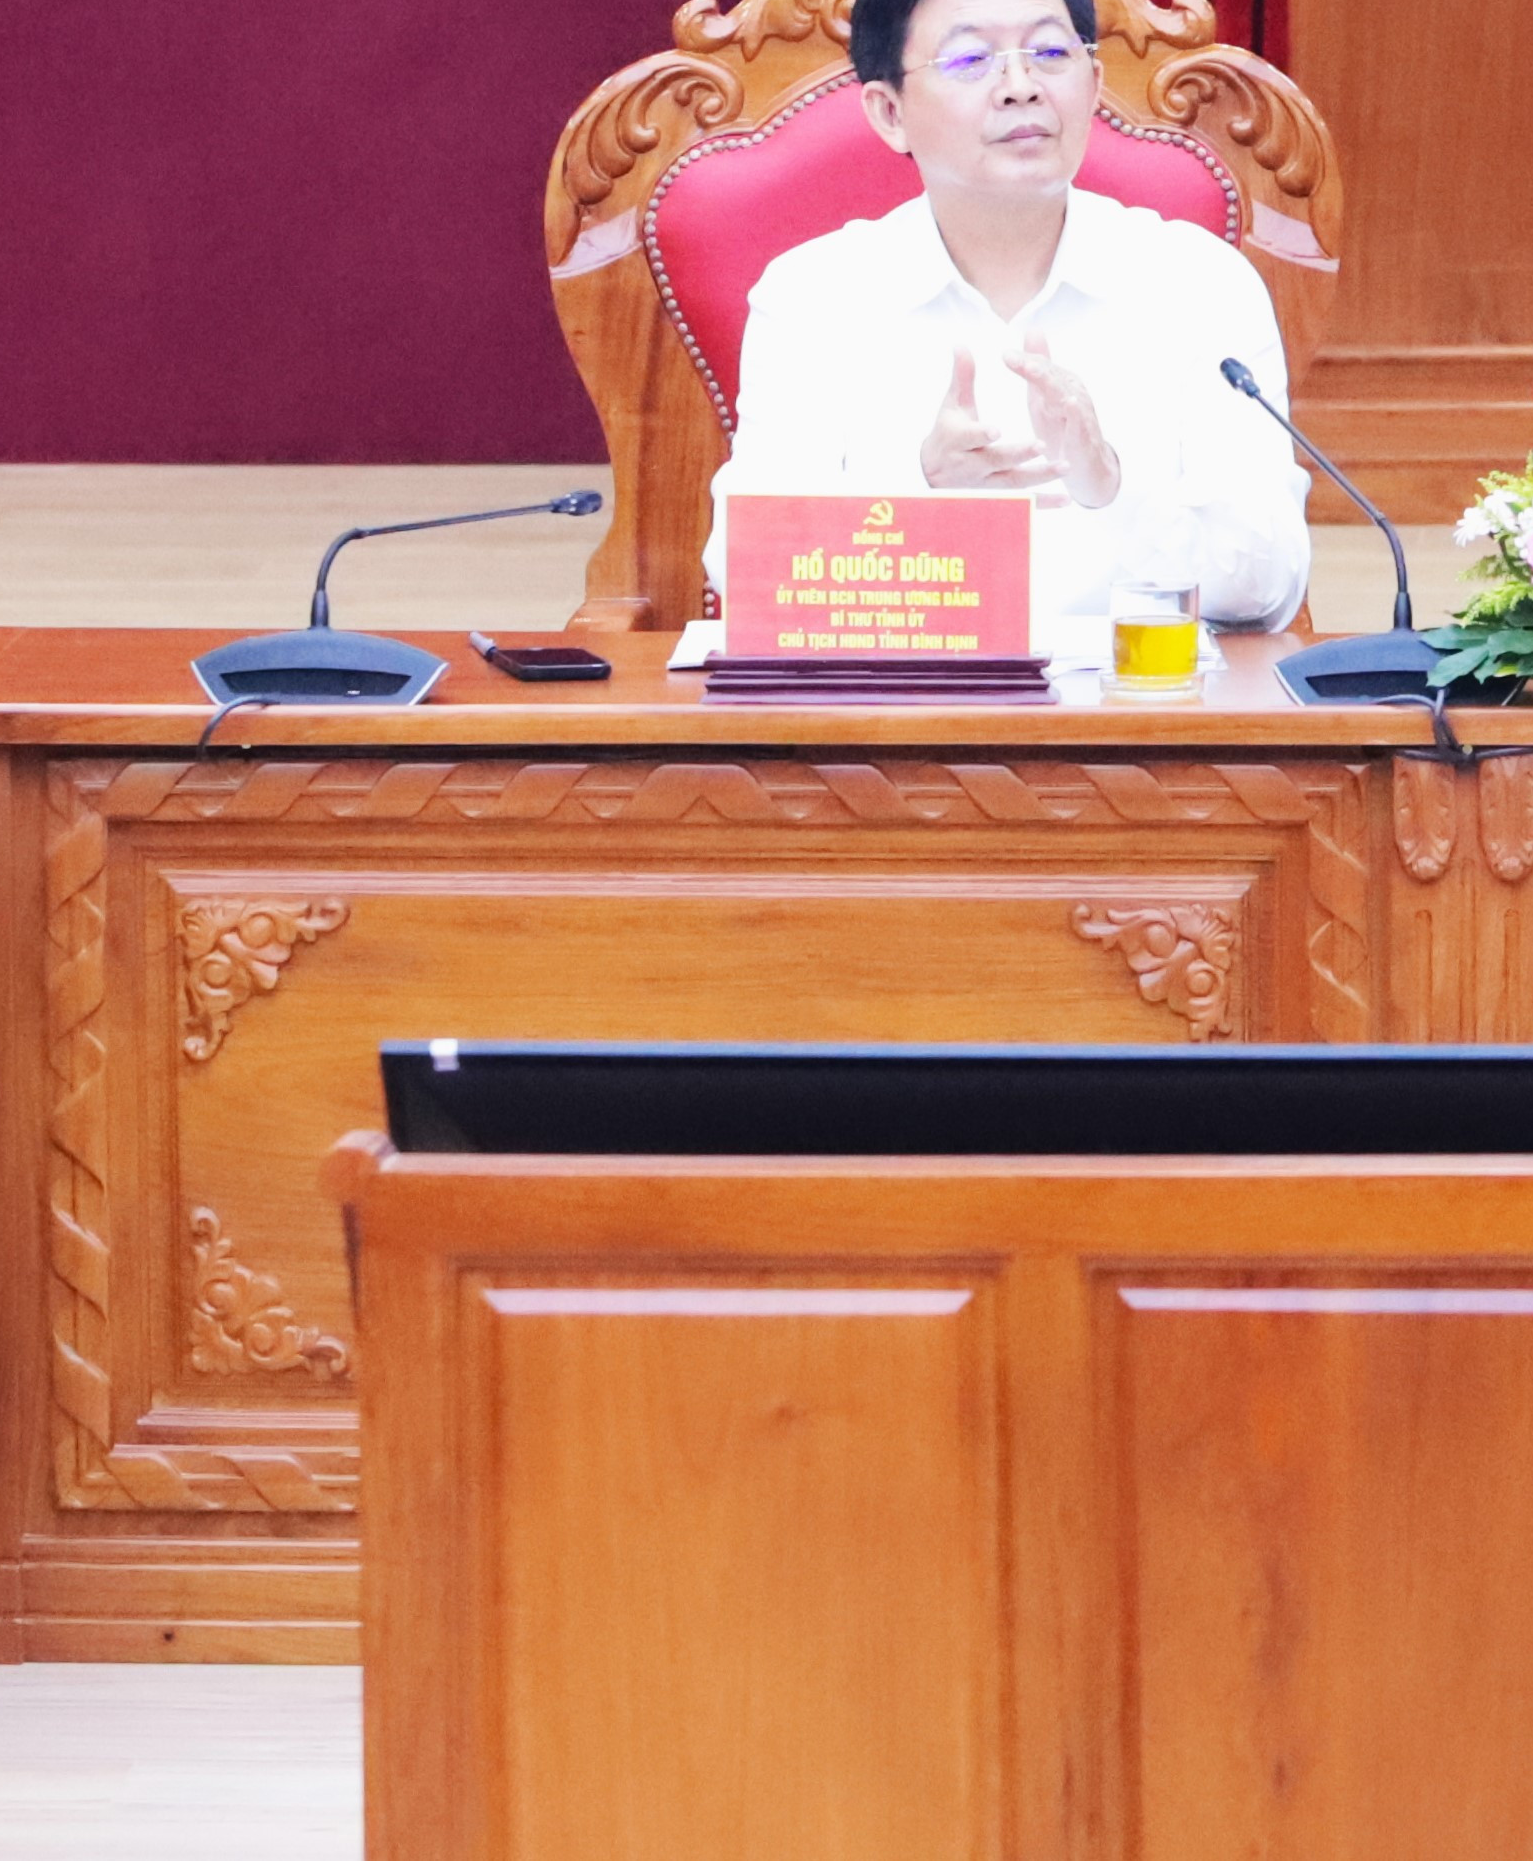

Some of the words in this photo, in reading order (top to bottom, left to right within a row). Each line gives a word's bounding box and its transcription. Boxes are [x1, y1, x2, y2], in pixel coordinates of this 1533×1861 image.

[792, 547, 824, 581] HỒ
[830, 548, 894, 584] QUỐC
[899, 552, 965, 582] DŨNG
[776, 584, 793, 605] ỦY
[796, 588, 827, 605] VIÊN
[858, 591, 902, 606] TRUNG
[875, 608, 906, 627] TỈNH
[908, 608, 926, 627] ỦY
[778, 628, 805, 648] CHỦ
[807, 633, 837, 651] TỊCH
[878, 630, 909, 649] TỈNH
